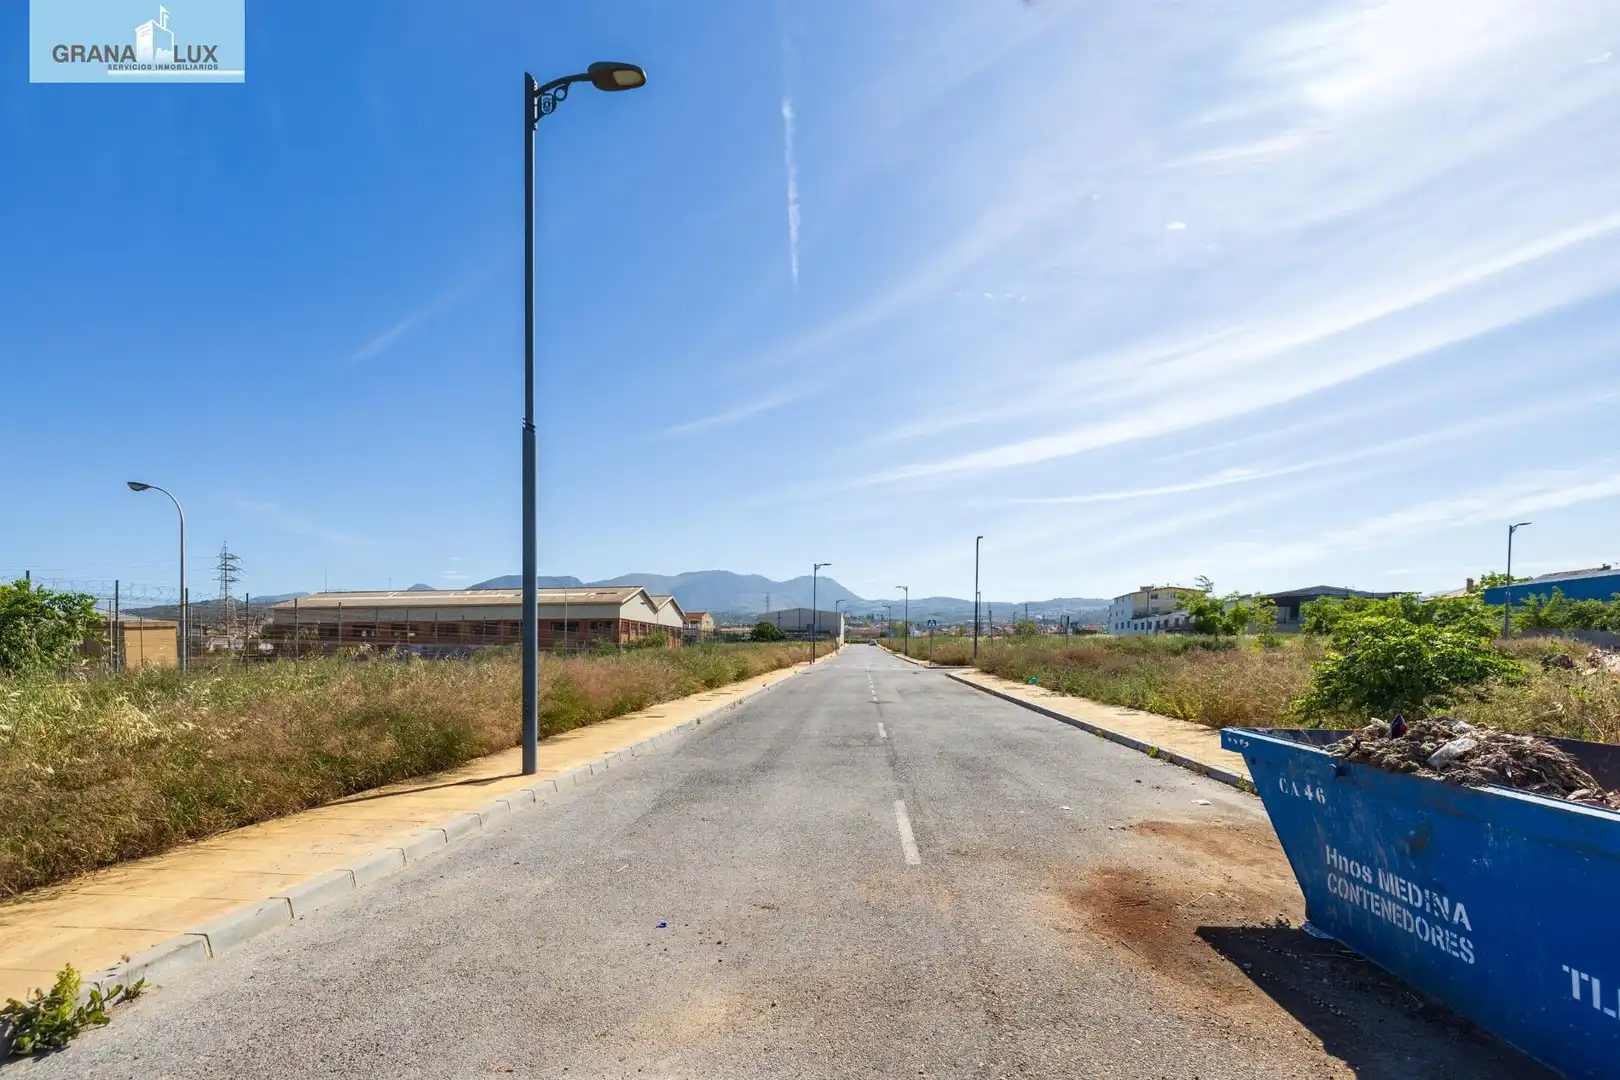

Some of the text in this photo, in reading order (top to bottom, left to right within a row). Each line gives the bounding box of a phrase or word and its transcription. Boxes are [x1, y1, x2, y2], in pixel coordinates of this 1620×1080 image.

[1325, 844, 1473, 932] Hnos MEDINA
[1327, 872, 1475, 964] CONTENEDORES
[1562, 964, 1620, 1020] TL
